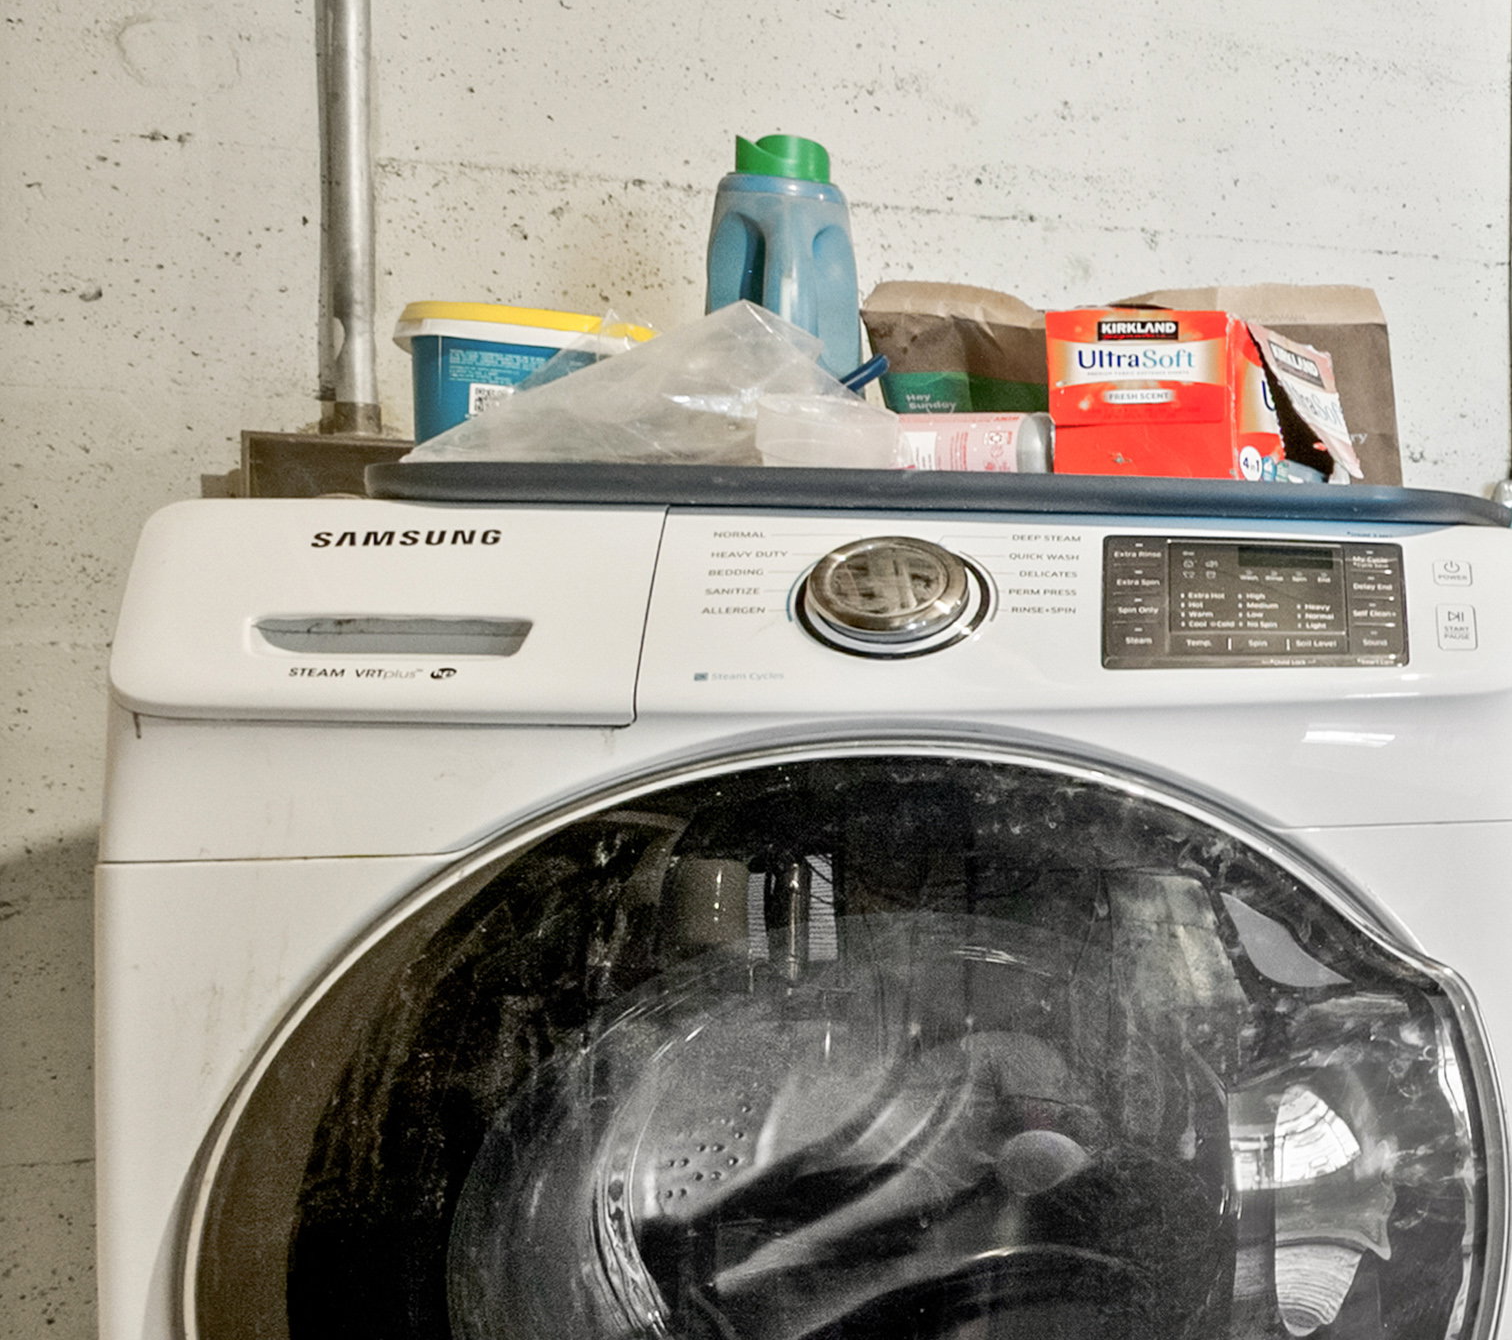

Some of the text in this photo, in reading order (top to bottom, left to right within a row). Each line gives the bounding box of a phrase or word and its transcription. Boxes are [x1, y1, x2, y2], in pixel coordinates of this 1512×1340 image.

[1101, 321, 1178, 335] KIRKLAND
[1078, 348, 1196, 369] UltraSoft
[905, 393, 932, 403] Hey
[1109, 392, 1169, 401] FRESH SCENT
[908, 401, 957, 410] Sunday
[311, 529, 502, 548] SAMSUNG
[713, 531, 766, 539] NORMAL
[1009, 552, 1043, 560] QUICK
[1019, 570, 1078, 578] DELICATES
[1141, 579, 1161, 588] Spin
[1353, 582, 1376, 591] Delay
[1043, 588, 1077, 596] PRESS
[702, 606, 766, 614] ALLERGEN
[1118, 606, 1159, 615] Spin Only
[288, 667, 345, 678] STEAM
[711, 672, 784, 681] Steam Cycles
